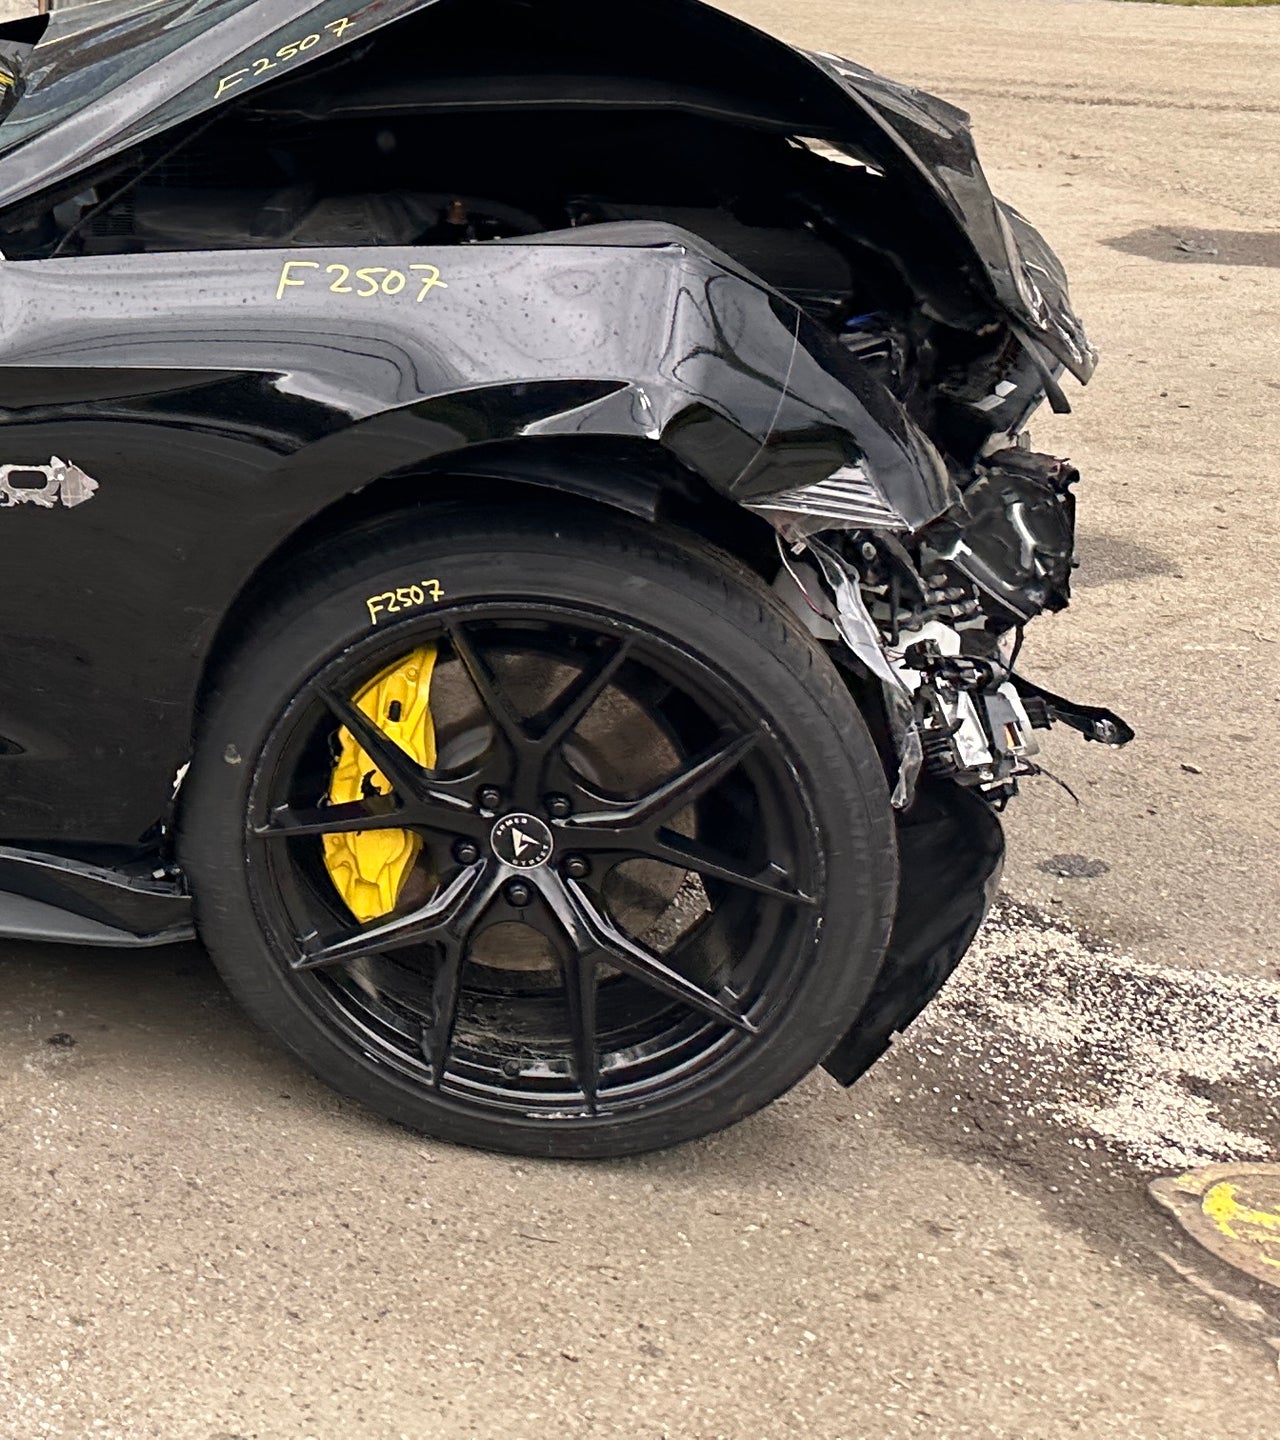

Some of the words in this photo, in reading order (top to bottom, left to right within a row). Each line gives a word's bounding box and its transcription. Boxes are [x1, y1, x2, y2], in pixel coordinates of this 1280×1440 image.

[213, 17, 356, 100] F2507
[276, 261, 449, 302] F2507
[366, 579, 445, 625] F2507
